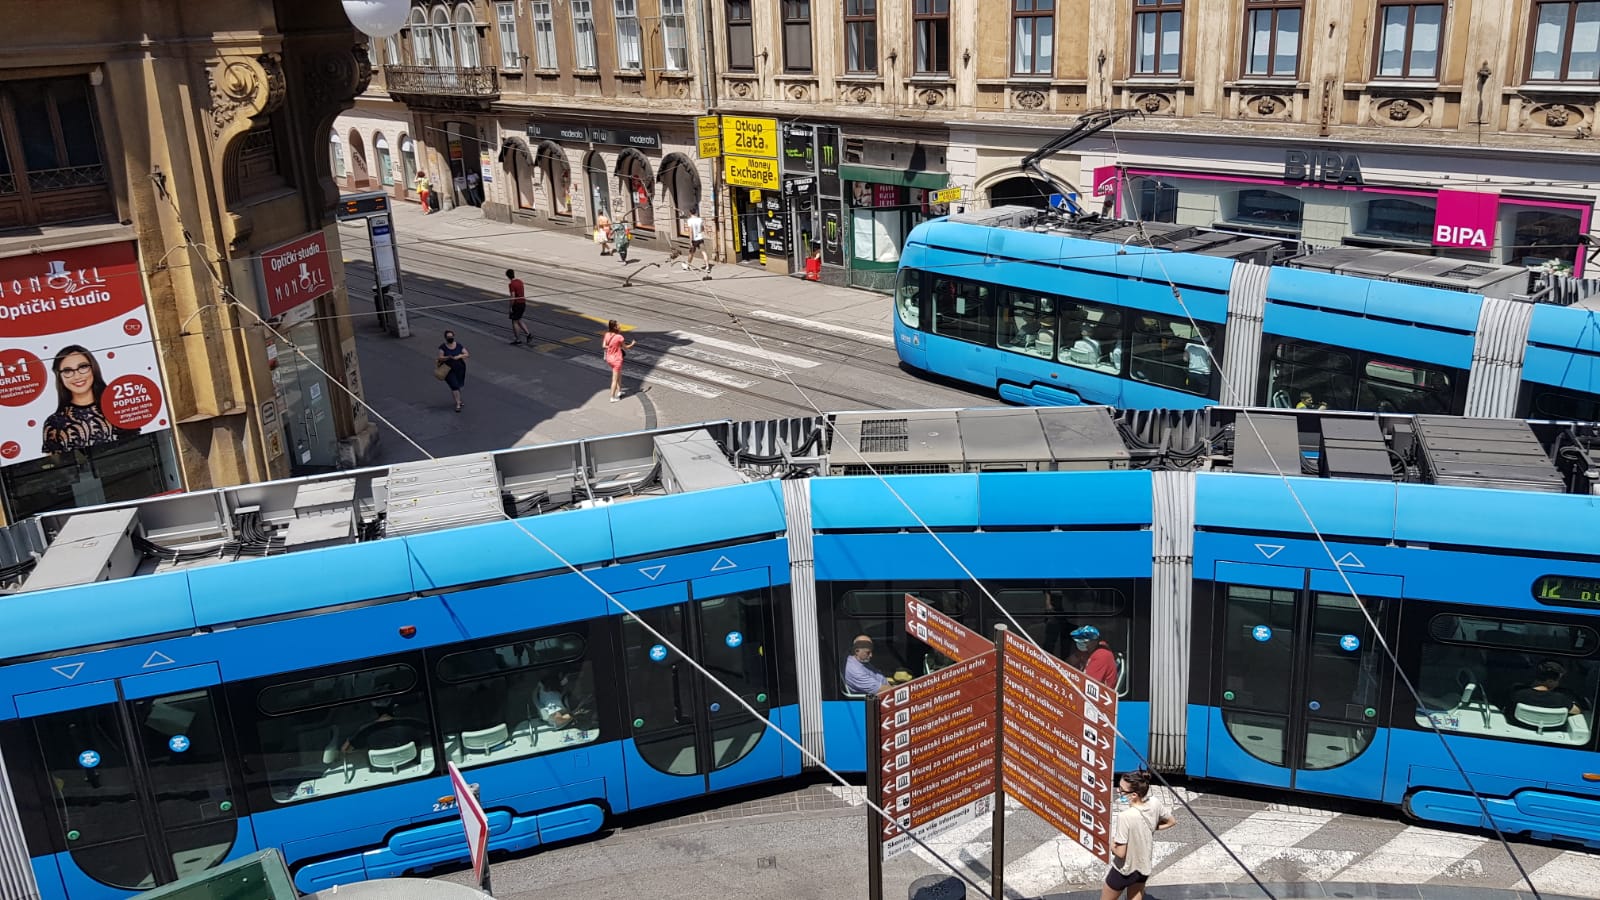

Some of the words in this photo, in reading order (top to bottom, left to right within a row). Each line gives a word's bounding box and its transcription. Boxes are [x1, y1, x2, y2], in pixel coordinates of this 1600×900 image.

[735, 120, 763, 136] Otkup
[735, 133, 765, 150] Zlata
[730, 166, 774, 183] Exchange
[748, 159, 771, 171] Money
[1284, 150, 1364, 185] BIPA
[1436, 224, 1487, 247] BIPA
[298, 242, 320, 261] studio
[0, 297, 57, 320] Optički
[61, 289, 111, 310] studio
[113, 382, 147, 400] 25%
[113, 394, 152, 408] POPUSTA
[1006, 633, 1024, 652] Muzej
[910, 674, 939, 692] Hrvatski
[941, 663, 966, 680] državni
[968, 656, 985, 670] arhiv
[1004, 653, 1020, 670] Tunel
[1022, 664, 1034, 678] Grič
[1039, 674, 1052, 689] ulaz
[1068, 691, 1072, 701] 4
[910, 698, 931, 714] Muzej
[933, 687, 960, 704] Mimara
[1004, 674, 1023, 694] Zagreb
[1024, 686, 1035, 701] Eye
[1036, 693, 1063, 718] vidikovac
[910, 713, 950, 736] Etnografski
[951, 704, 972, 719] muzej
[1018, 703, 1027, 717] Trg
[1029, 710, 1044, 727] bana
[911, 737, 939, 756] Hrvatski
[941, 727, 965, 743] školski
[966, 718, 986, 734] muzej
[911, 762, 931, 778] Muzej
[942, 744, 974, 765] umjetnost
[979, 736, 993, 747] obrt
[911, 780, 939, 798] Hrvatsko
[940, 768, 965, 785] narodno
[967, 756, 992, 773] kazalište
